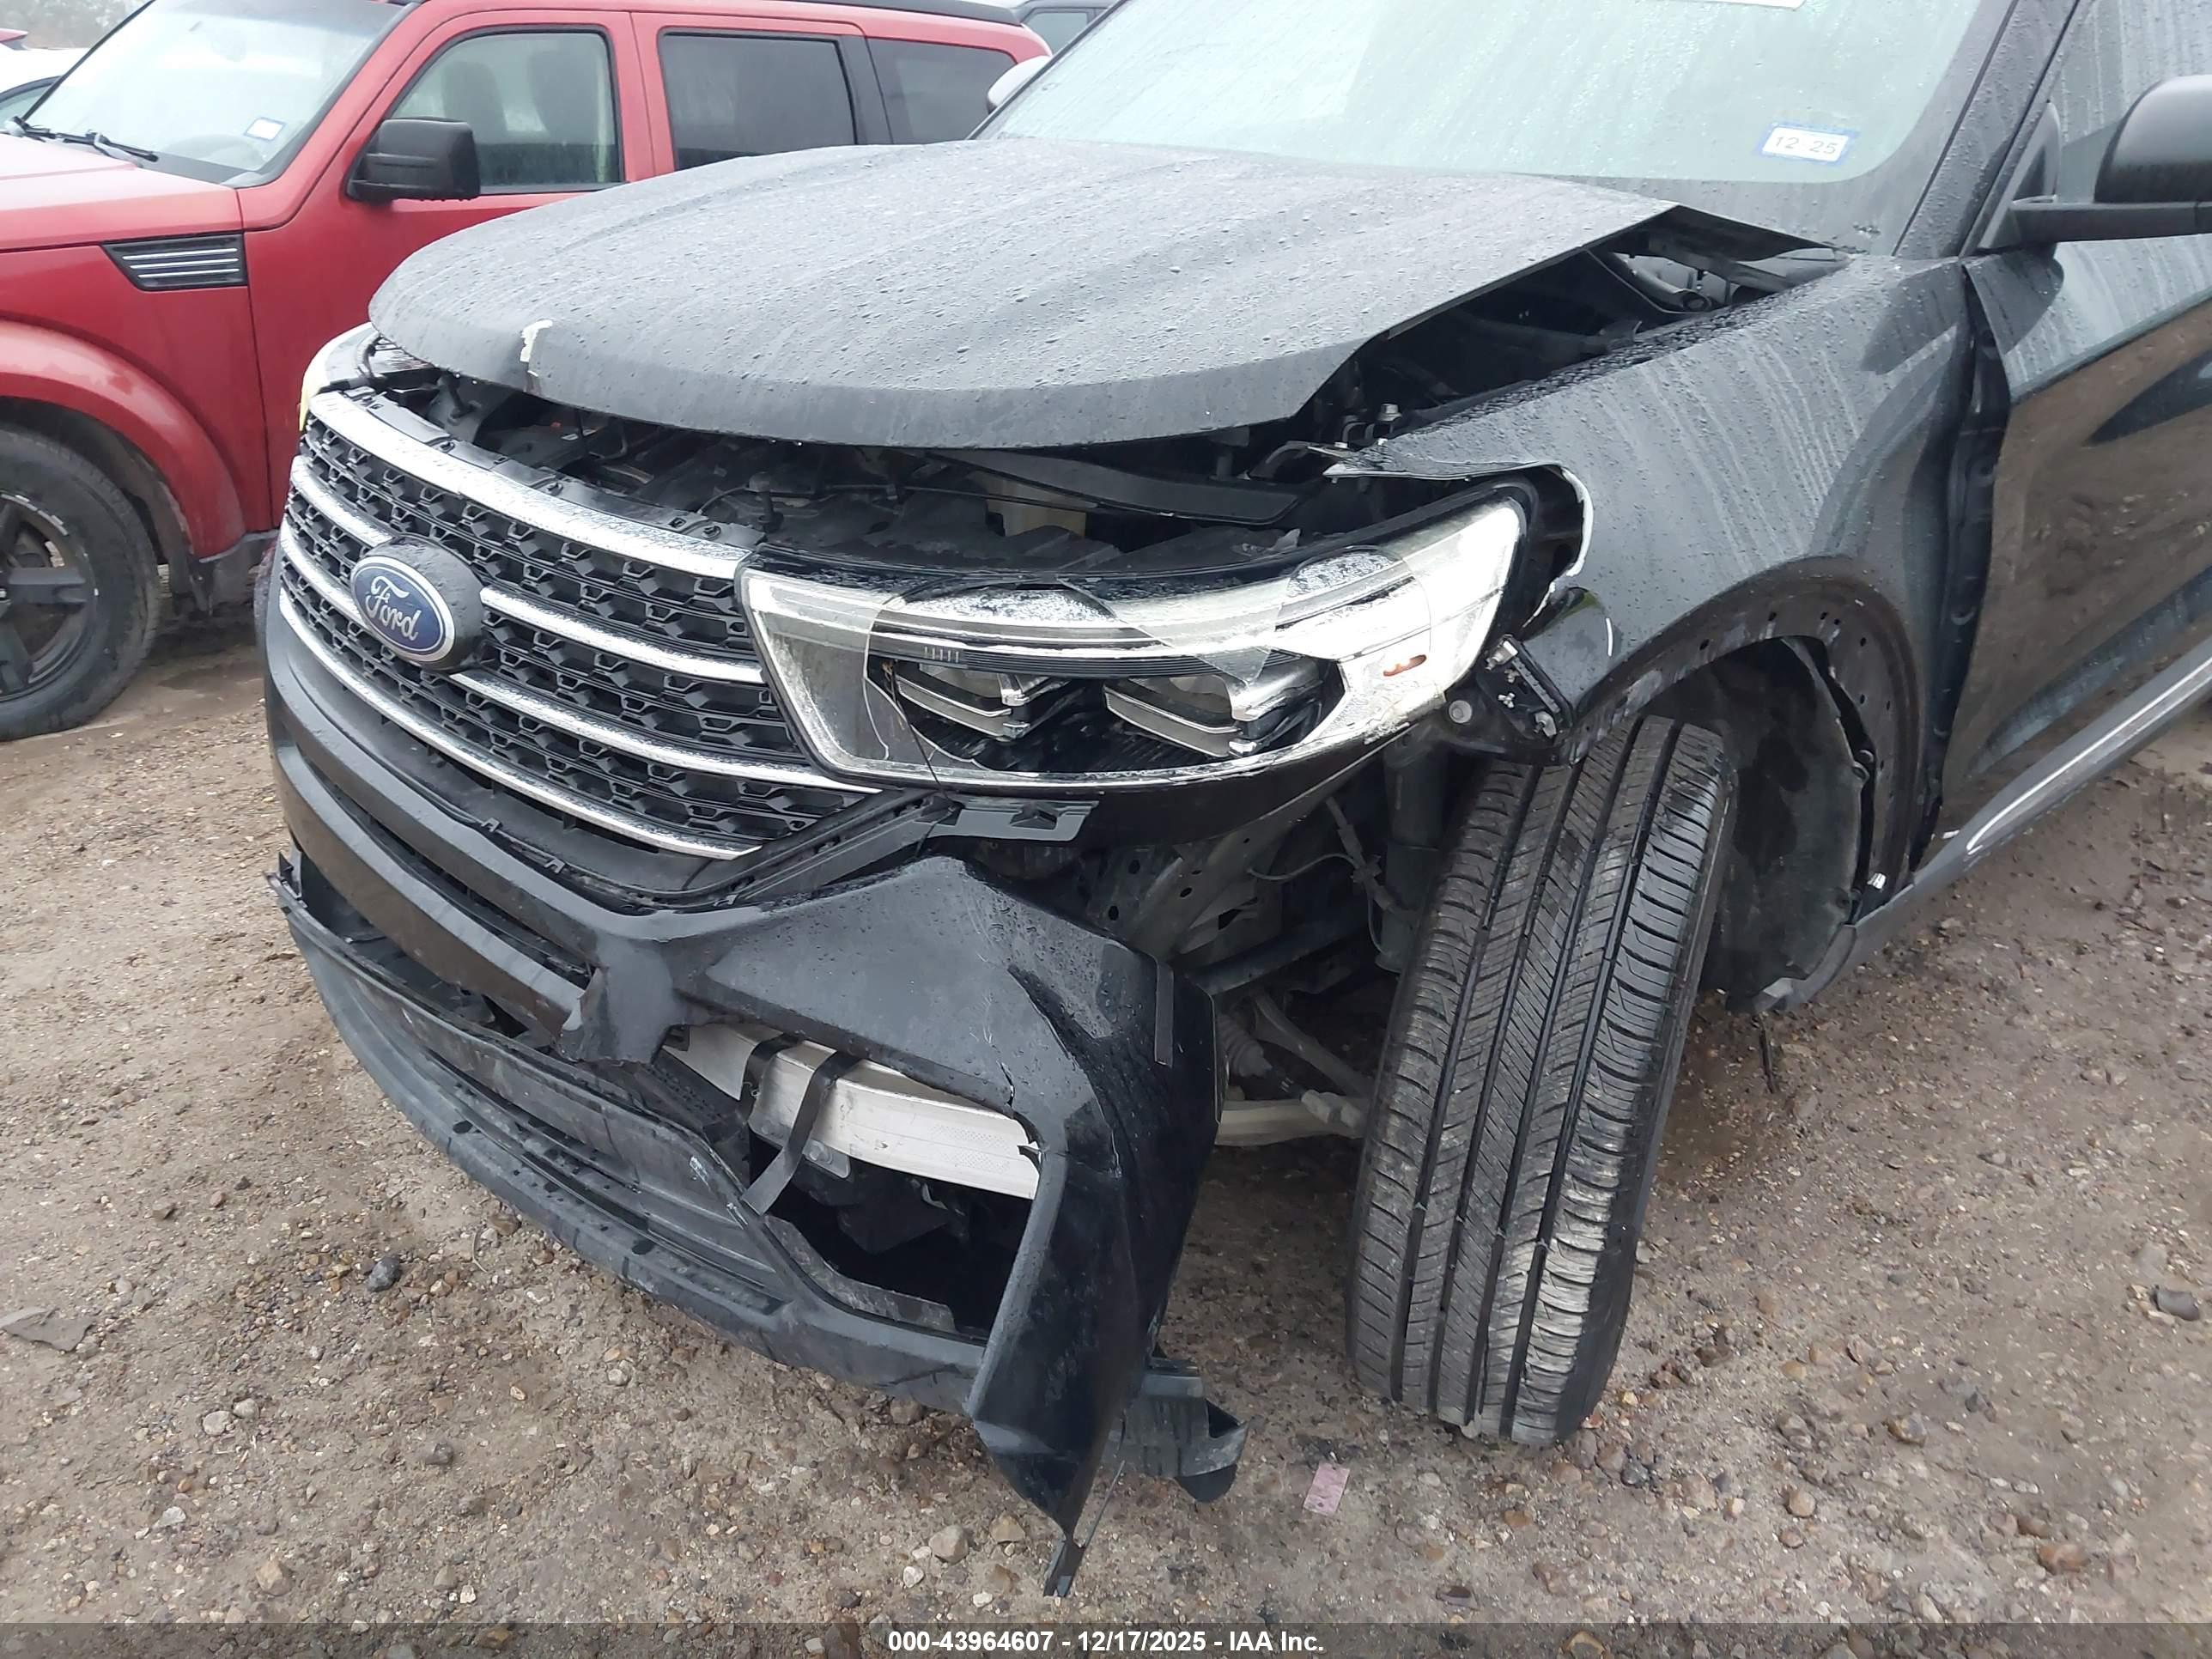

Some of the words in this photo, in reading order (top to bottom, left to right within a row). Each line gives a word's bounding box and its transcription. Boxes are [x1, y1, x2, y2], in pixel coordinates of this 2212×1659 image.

[1775, 137, 1800, 149] 12
[1808, 140, 1838, 155] 25
[364, 575, 422, 641] Ford
